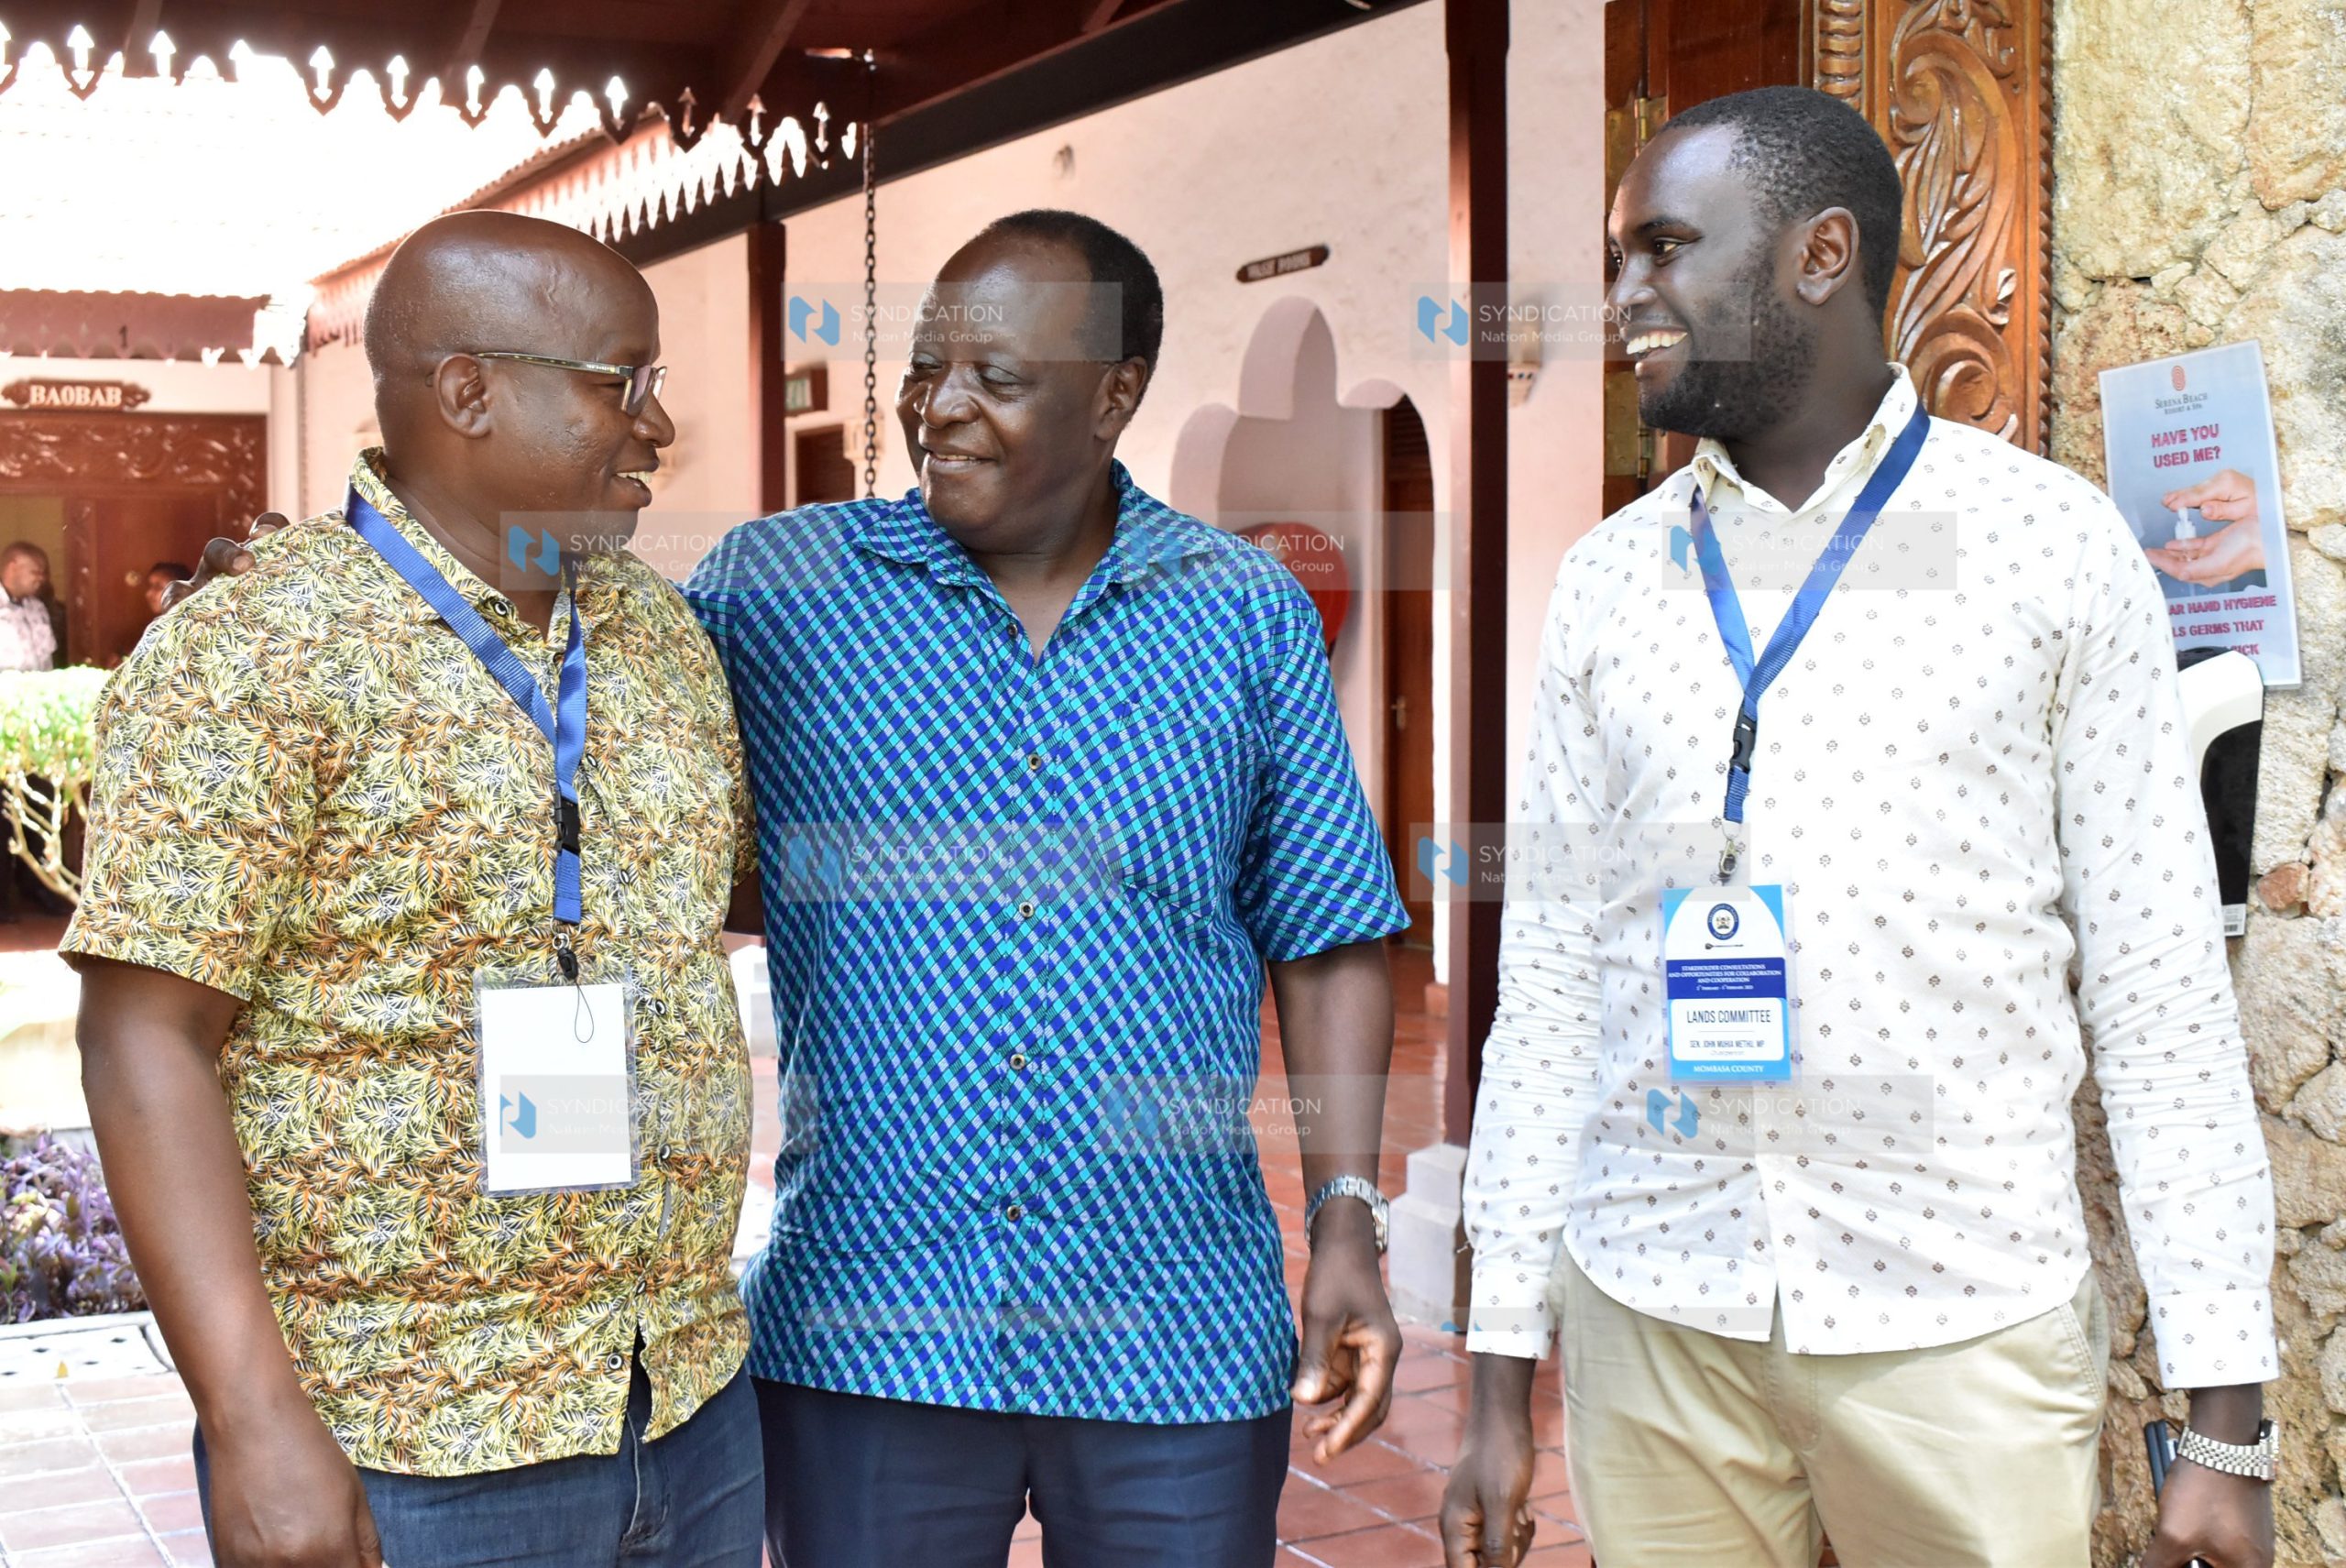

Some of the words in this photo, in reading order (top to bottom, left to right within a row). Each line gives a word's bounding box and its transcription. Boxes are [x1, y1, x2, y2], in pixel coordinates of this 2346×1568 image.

[29, 385, 122, 407] BAOBAB
[2152, 429, 2187, 448] HAVE
[2190, 423, 2219, 441] YOU
[2154, 451, 2189, 468] USED
[2193, 445, 2220, 462] ME?
[2169, 603, 2185, 615] AR
[2187, 600, 2220, 613] HAND
[2224, 595, 2276, 610] HYGIENE
[2173, 626, 2186, 637] LS
[2189, 623, 2231, 636] GERMS
[2233, 620, 2264, 632] THAT
[1687, 1010, 1716, 1023] LANDS
[1718, 1010, 1770, 1023] COMMITTEE
